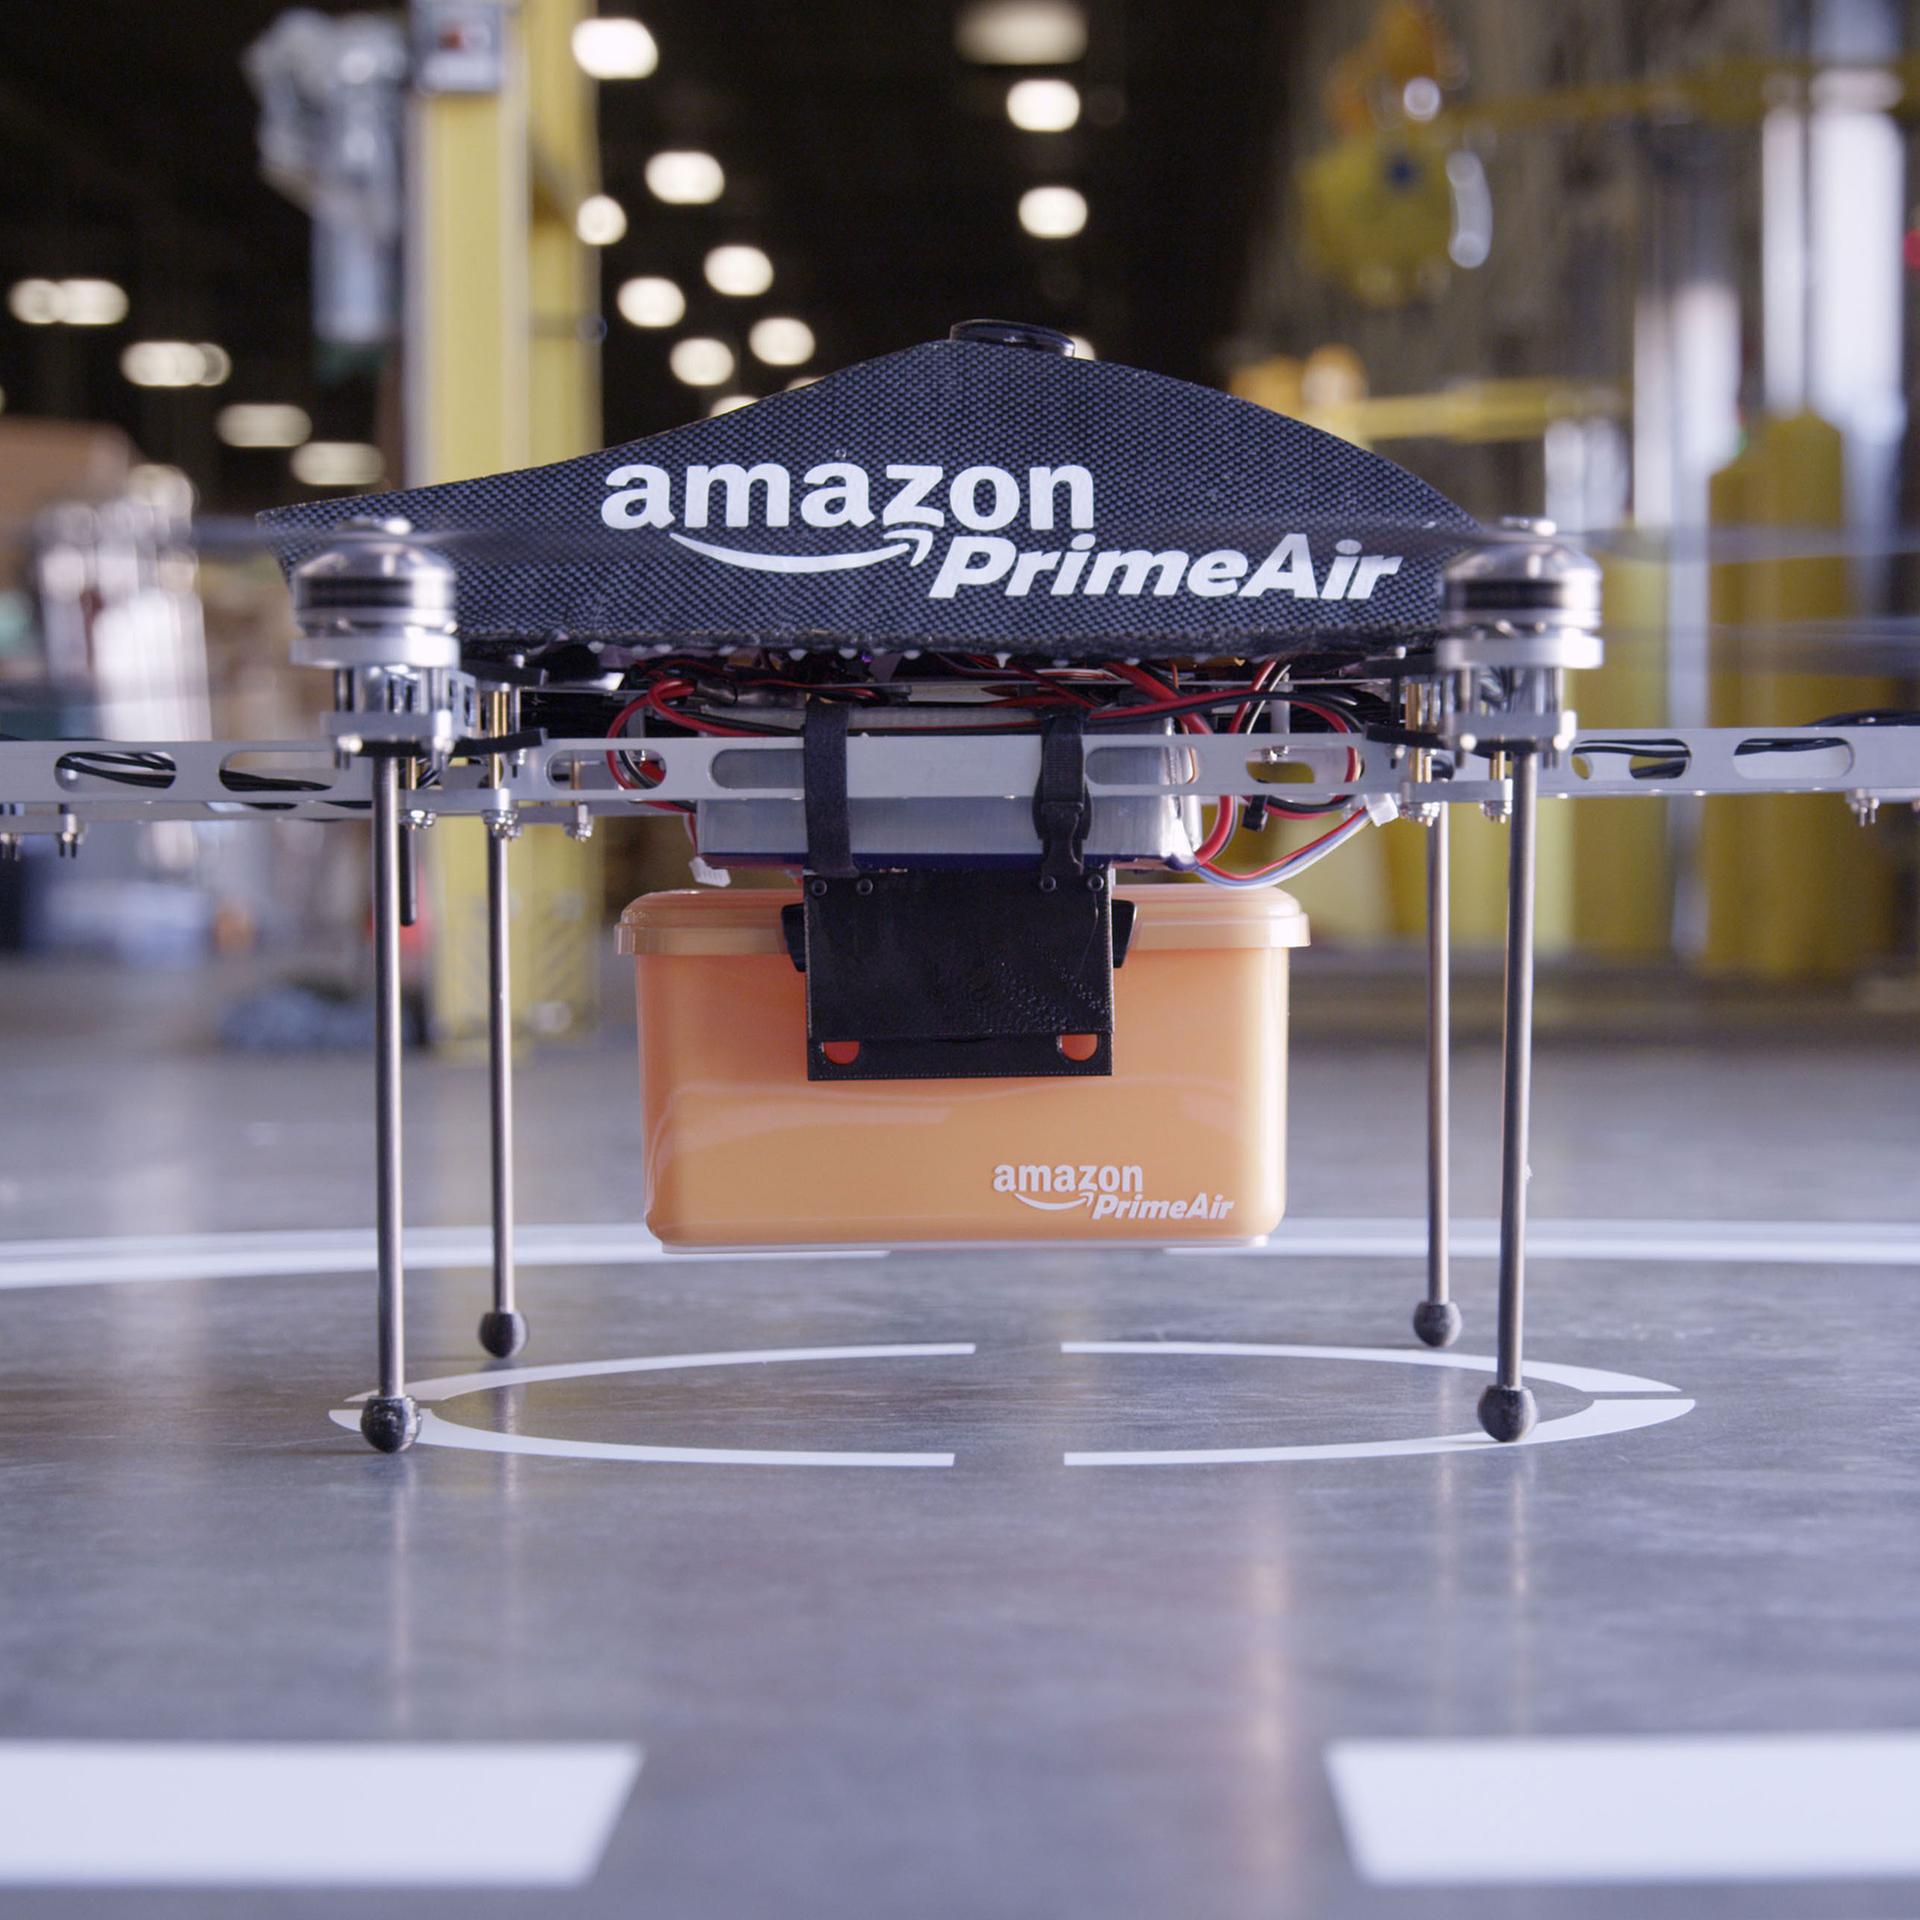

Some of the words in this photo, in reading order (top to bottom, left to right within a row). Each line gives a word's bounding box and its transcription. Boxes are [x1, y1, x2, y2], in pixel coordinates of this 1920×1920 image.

[601, 463, 1094, 531] amazon
[929, 533, 1401, 600] PrimeAir
[993, 1164, 1143, 1192] amazon
[1092, 1193, 1234, 1220] PrimeAir
